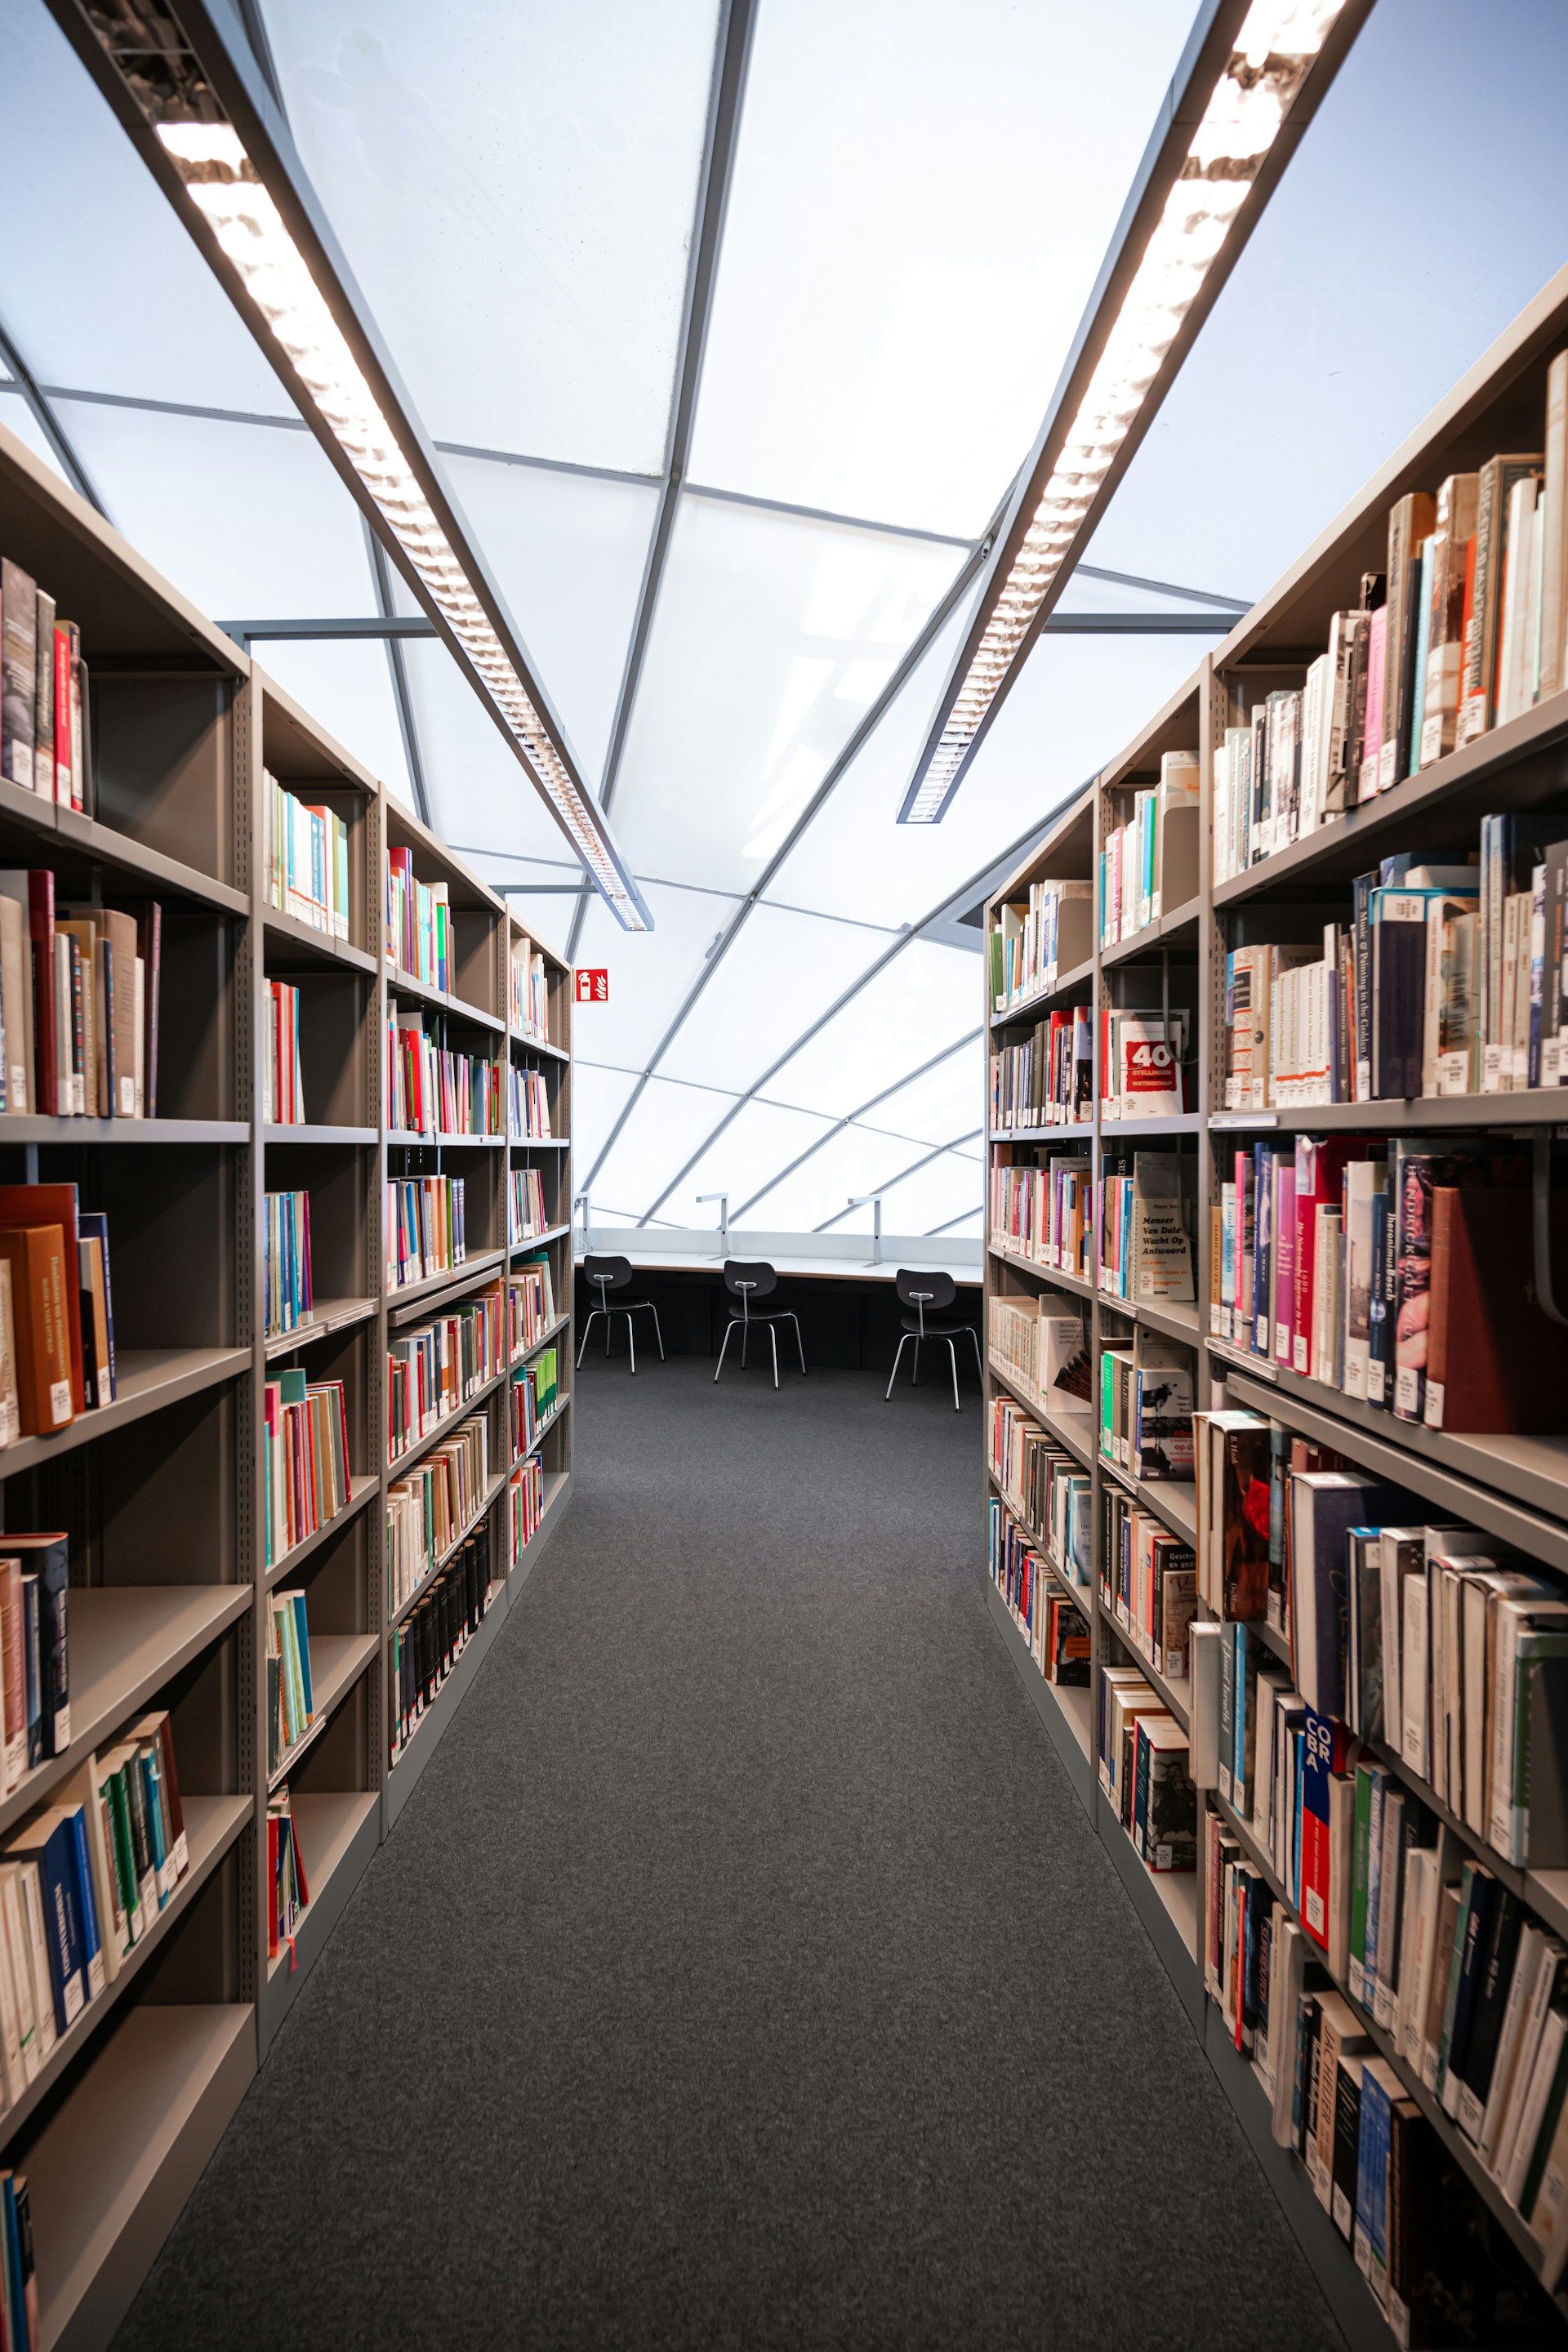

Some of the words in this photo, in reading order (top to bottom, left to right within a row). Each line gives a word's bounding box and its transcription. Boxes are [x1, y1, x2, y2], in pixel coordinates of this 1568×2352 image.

[1359, 911, 1369, 939] Music
[1359, 942, 1368, 951] &
[1357, 952, 1369, 991] Painting
[1360, 991, 1369, 1001] in
[1360, 1003, 1369, 1016] the
[1359, 1019, 1369, 1054] Golden
[1449, 1013, 1467, 1042] HAKS
[1132, 1045, 1172, 1067] 40
[1405, 1164, 1417, 1256] HENDRICK
[1143, 1247, 1186, 1255] Antwoord
[1171, 1236, 1183, 1245] Op
[1222, 1650, 1232, 1685] Jozef
[1222, 1686, 1231, 1724] Israëls
[1306, 1716, 1331, 1746] CO
[1307, 1736, 1330, 1765] BR
[1258, 1924, 1268, 2006] SUPERDUTCH
[1324, 2026, 1335, 2059] JAC
